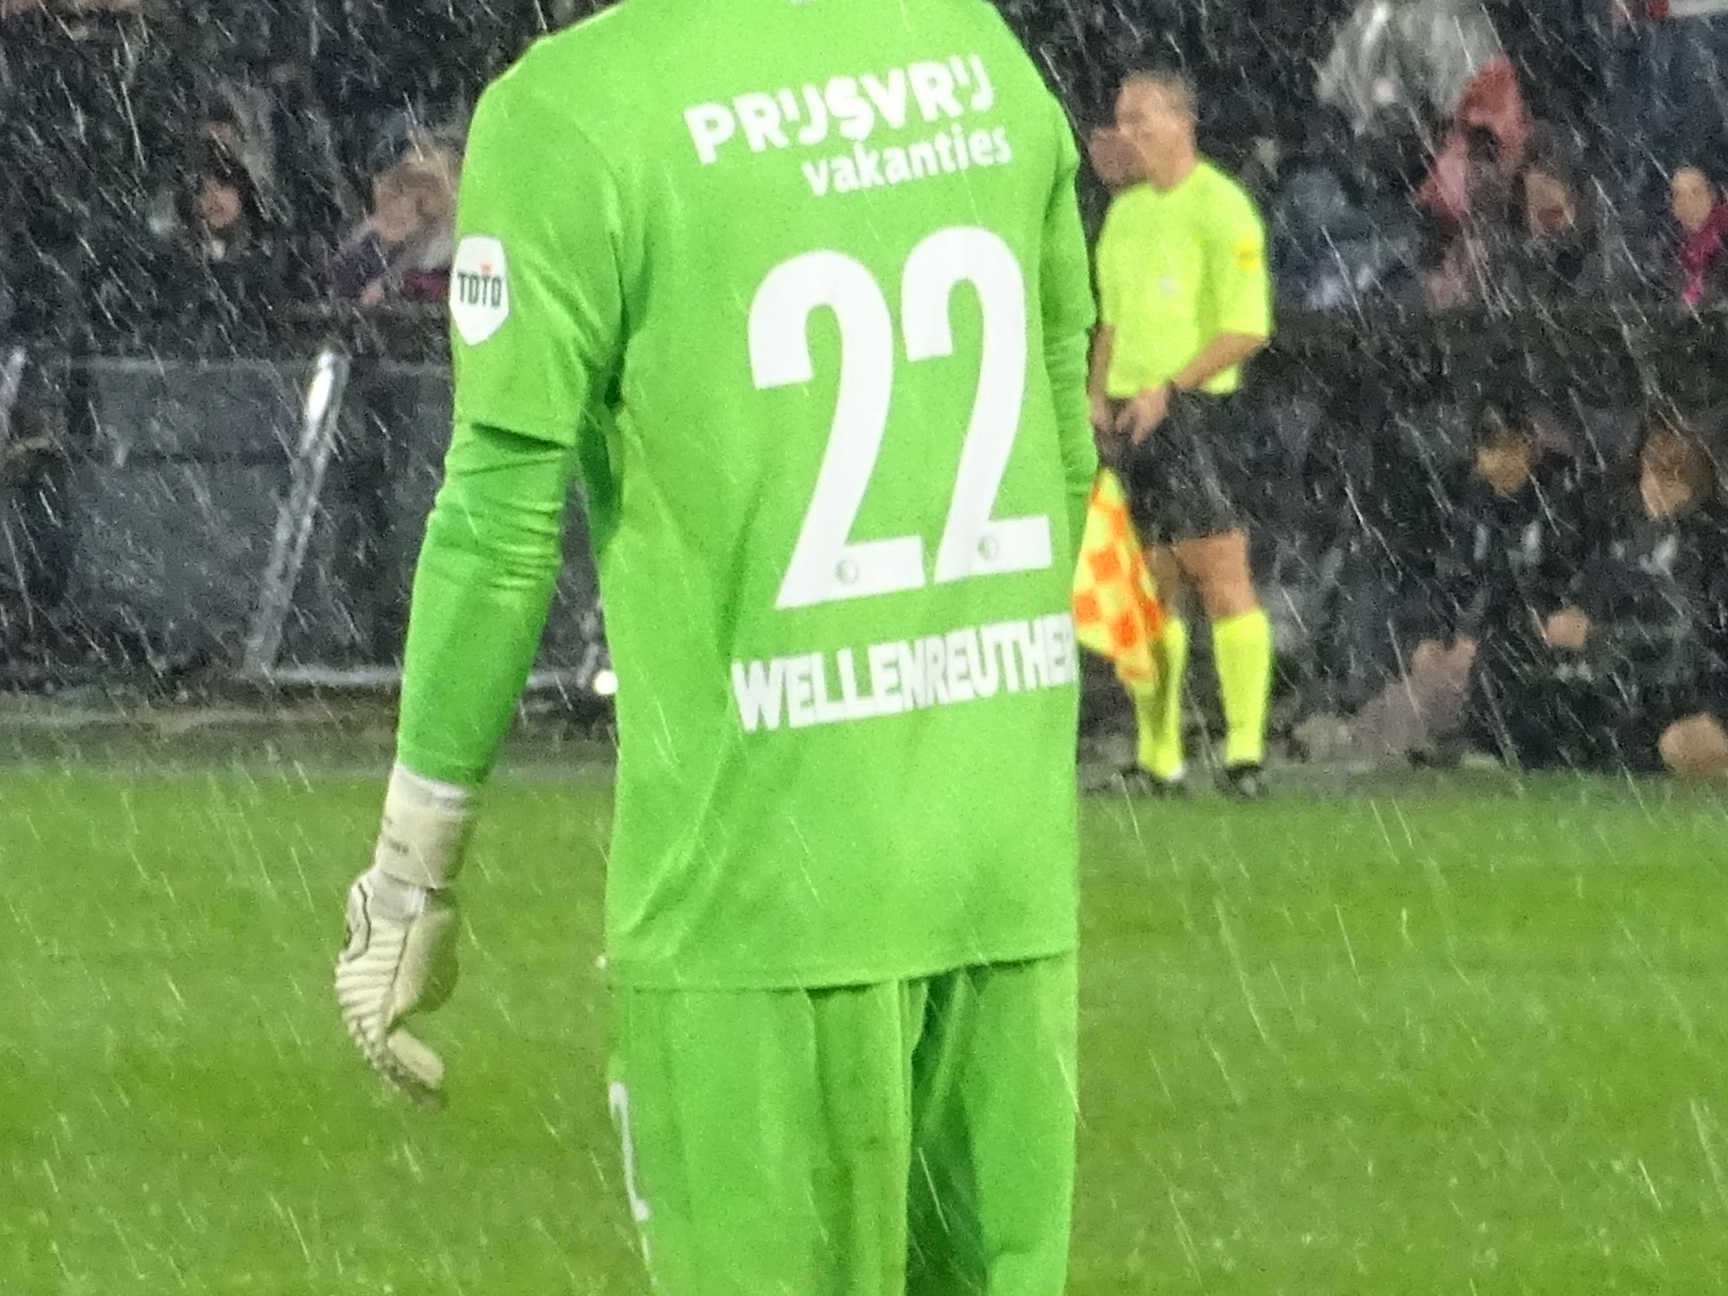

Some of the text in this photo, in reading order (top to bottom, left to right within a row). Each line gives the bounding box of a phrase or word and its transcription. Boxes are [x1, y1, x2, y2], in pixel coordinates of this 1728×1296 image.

[684, 54, 994, 165] PRIJSVRIJ
[801, 123, 1013, 197] vakanties
[457, 271, 503, 307] TOTO
[748, 225, 1053, 610] 22
[731, 612, 1076, 732] WELLENREUTHE
